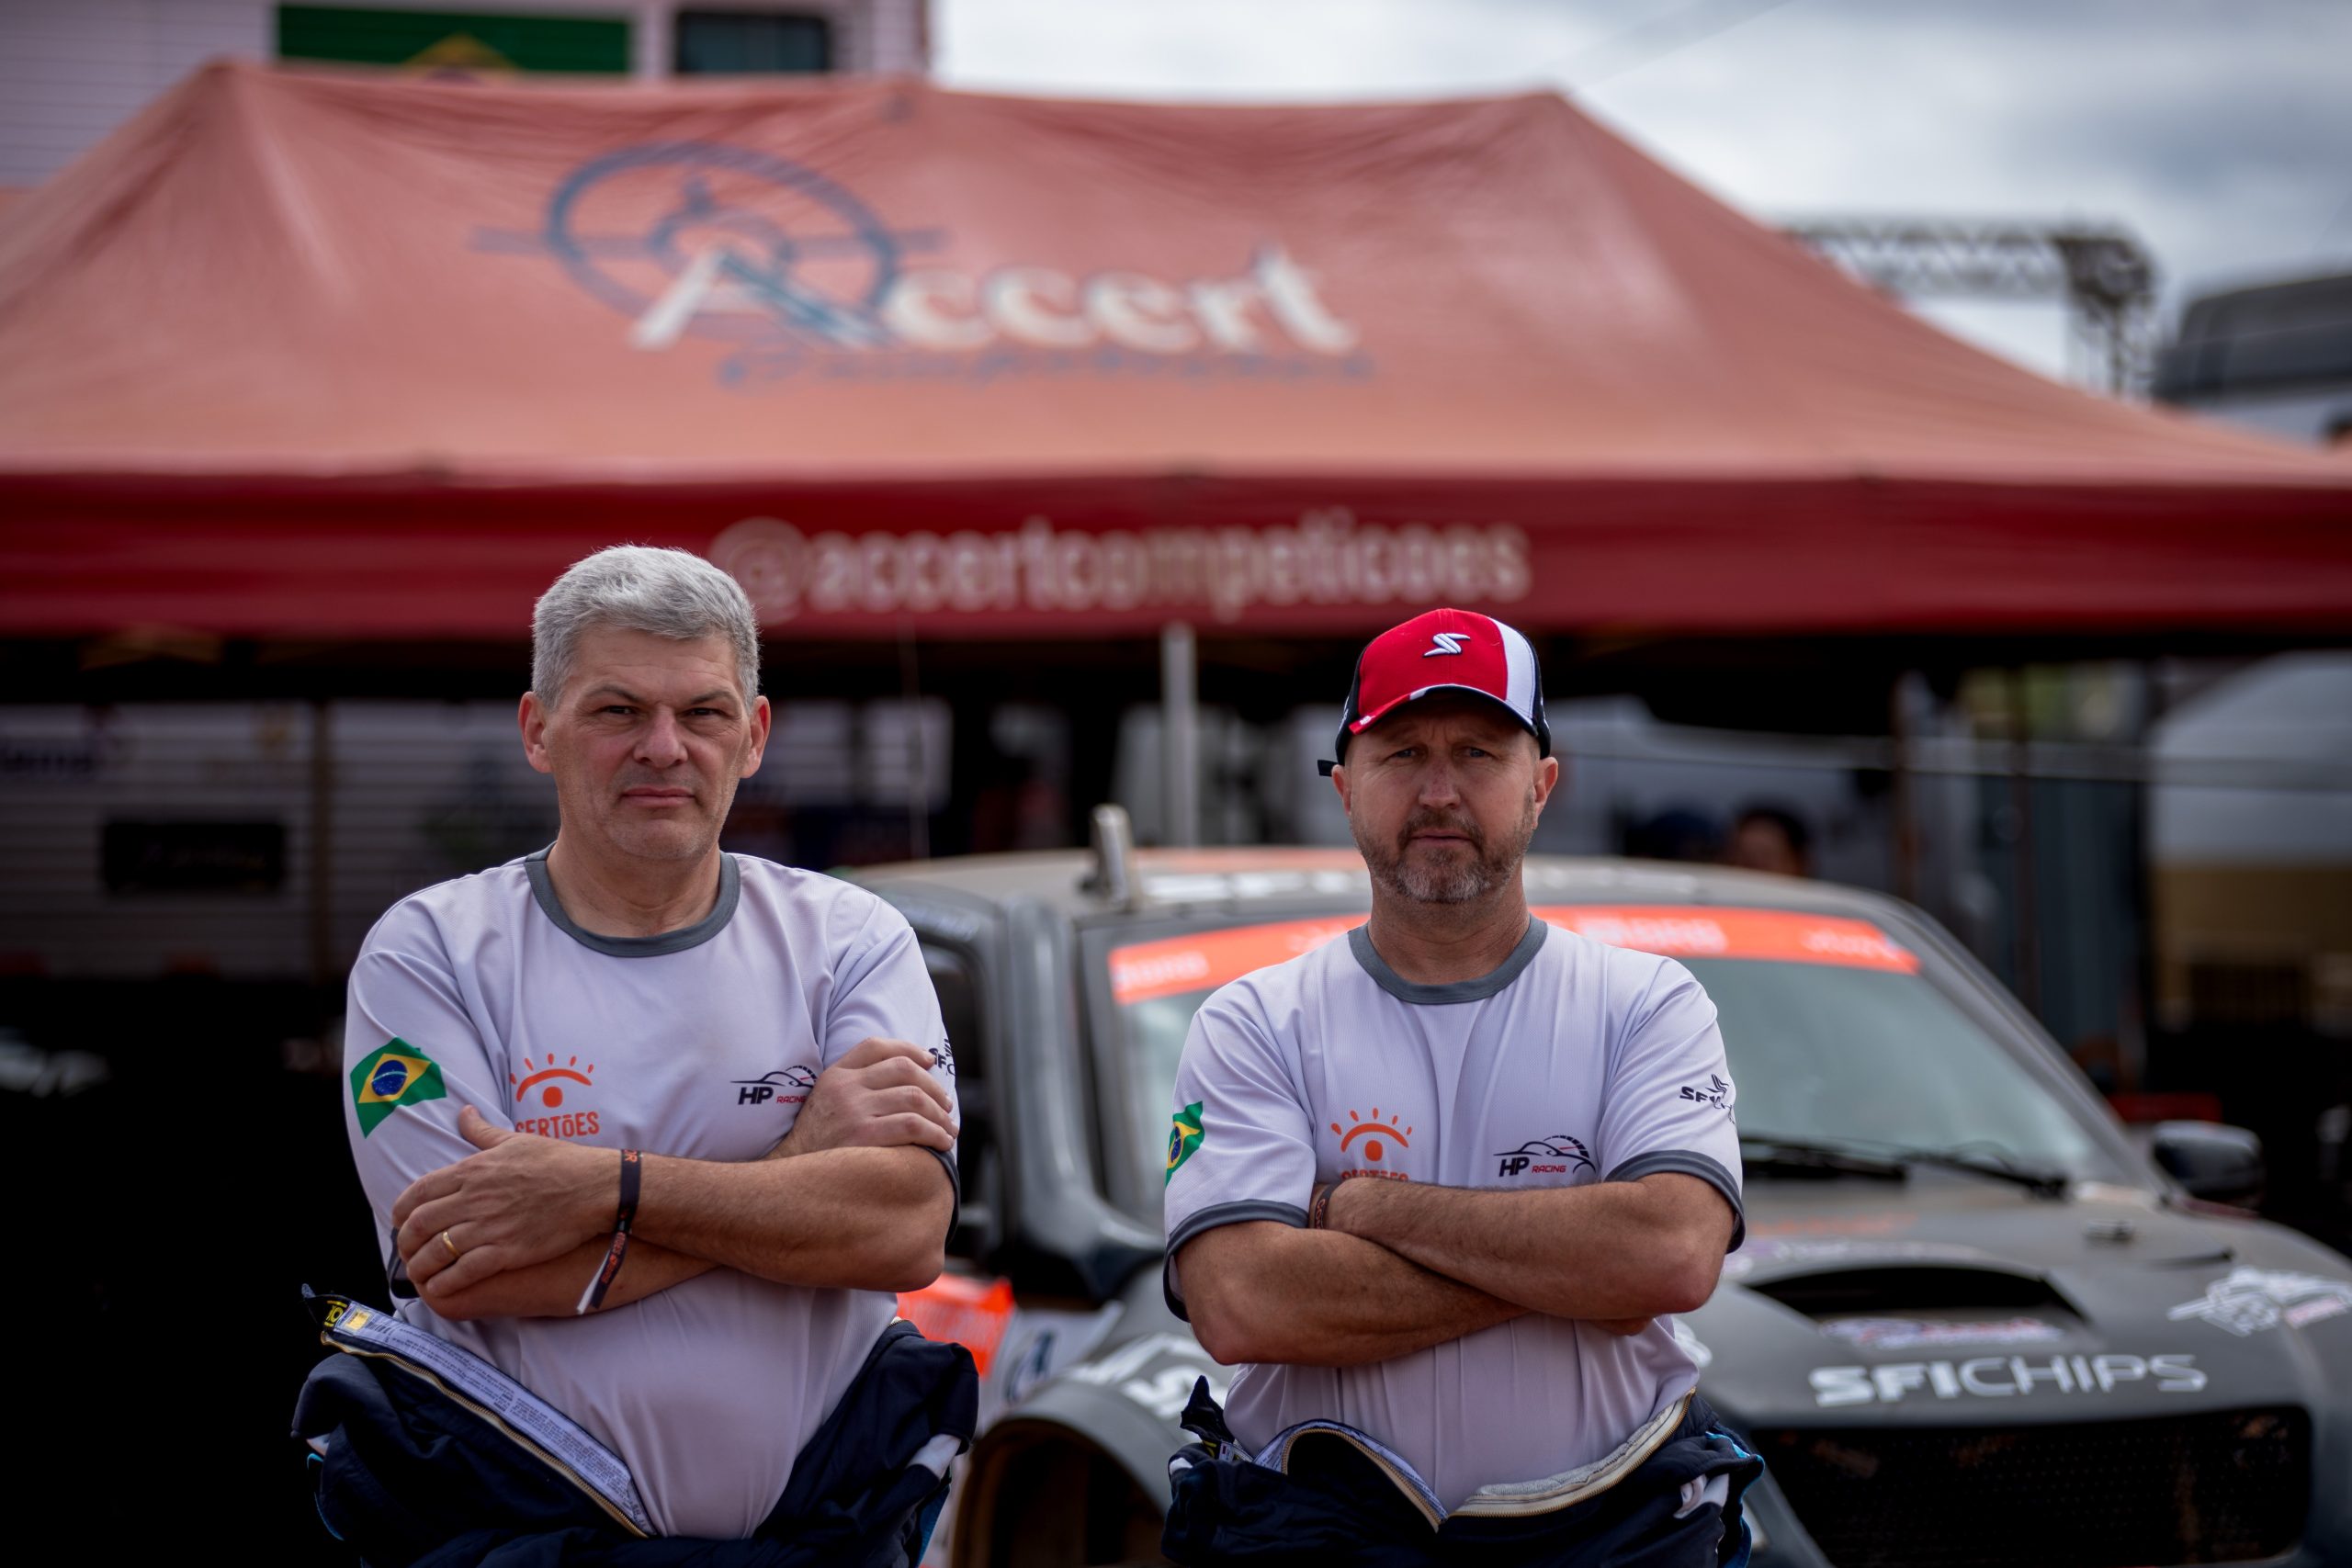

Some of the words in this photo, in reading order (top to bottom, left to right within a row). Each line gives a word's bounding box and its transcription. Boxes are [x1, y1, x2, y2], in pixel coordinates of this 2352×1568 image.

[738, 1086, 775, 1105] HP
[1498, 1156, 1530, 1177] HP
[1532, 1165, 1566, 1174] RACING
